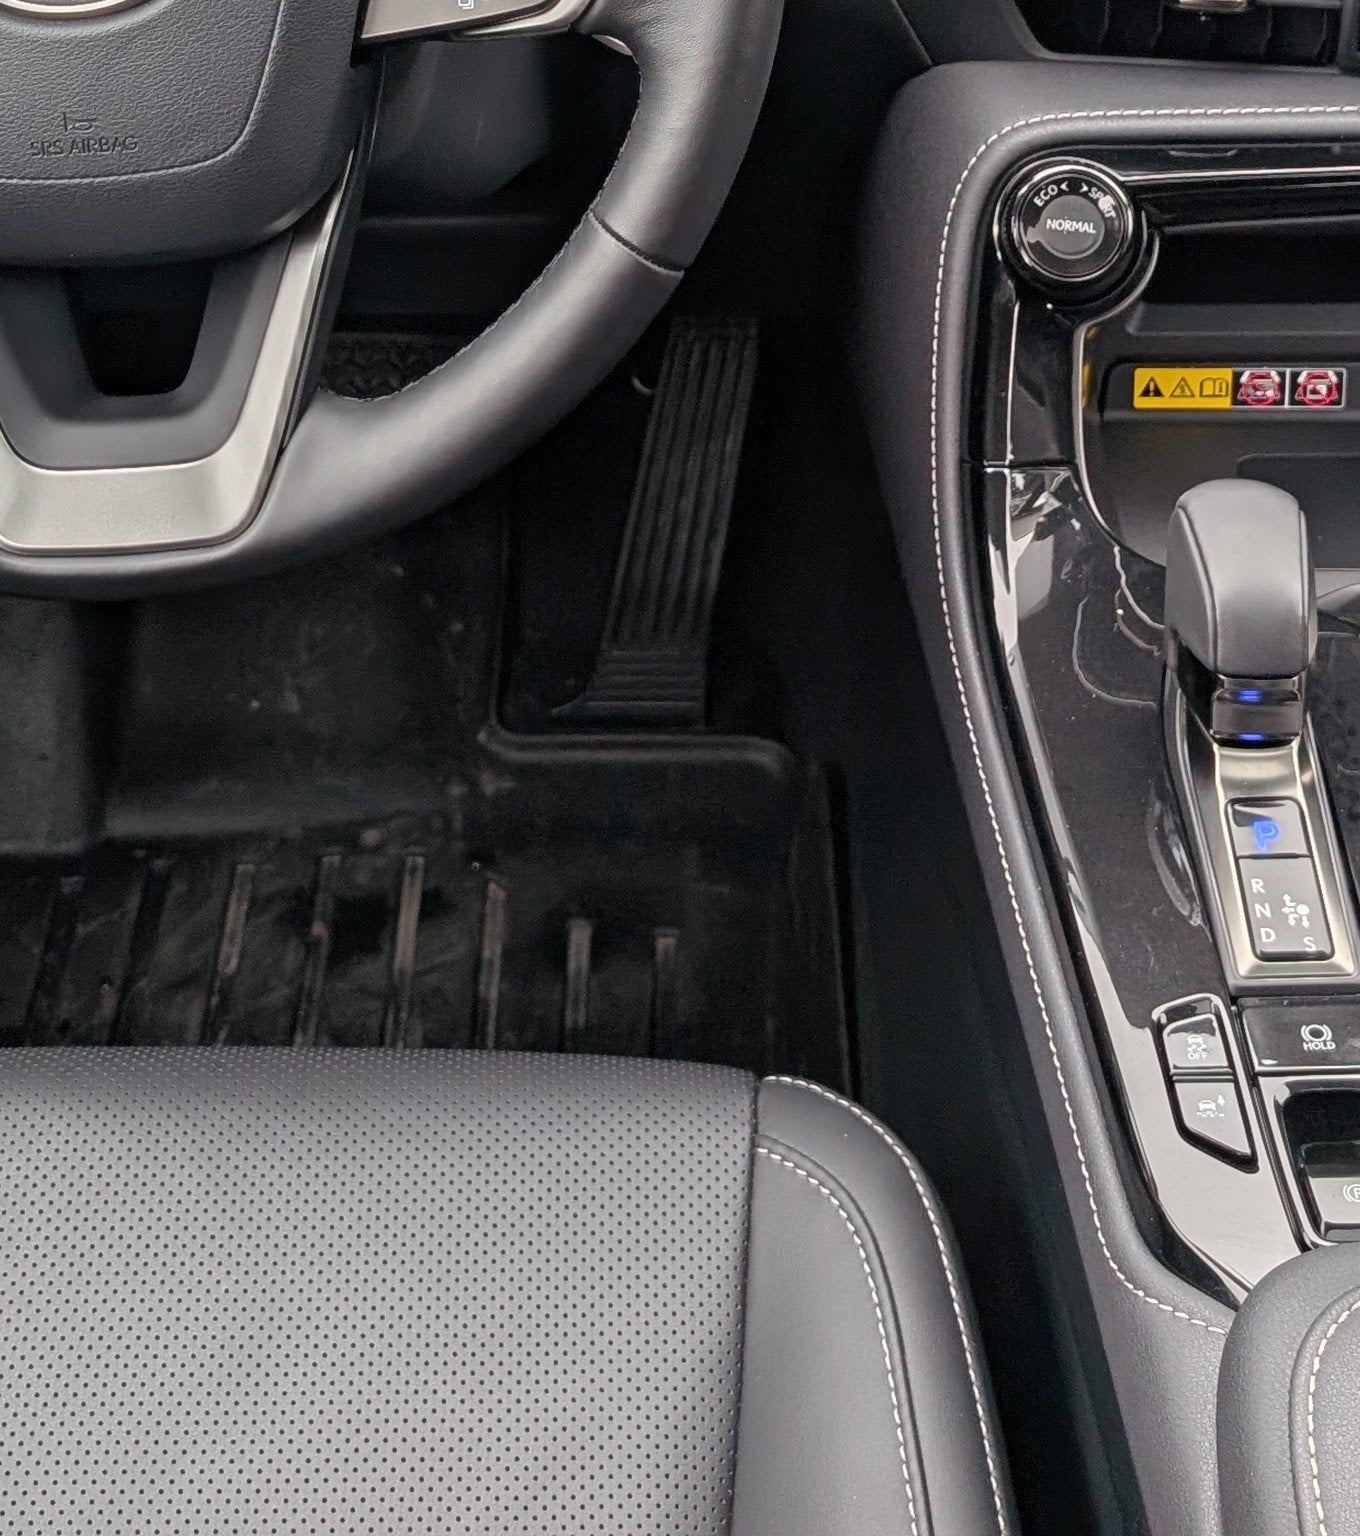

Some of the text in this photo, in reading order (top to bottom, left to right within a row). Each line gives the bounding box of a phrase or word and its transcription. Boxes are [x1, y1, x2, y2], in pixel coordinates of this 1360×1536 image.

[69, 135, 140, 156] AIRBAG
[1033, 184, 1059, 208] ECO
[1045, 217, 1097, 234] NORMAL
[1252, 819, 1279, 850] P
[1251, 878, 1265, 894] R
[1254, 902, 1272, 918] N
[1258, 927, 1276, 943] D
[1303, 936, 1318, 951] S
[1303, 1041, 1336, 1051] HOLD
[1187, 1052, 1208, 1060] OFF
